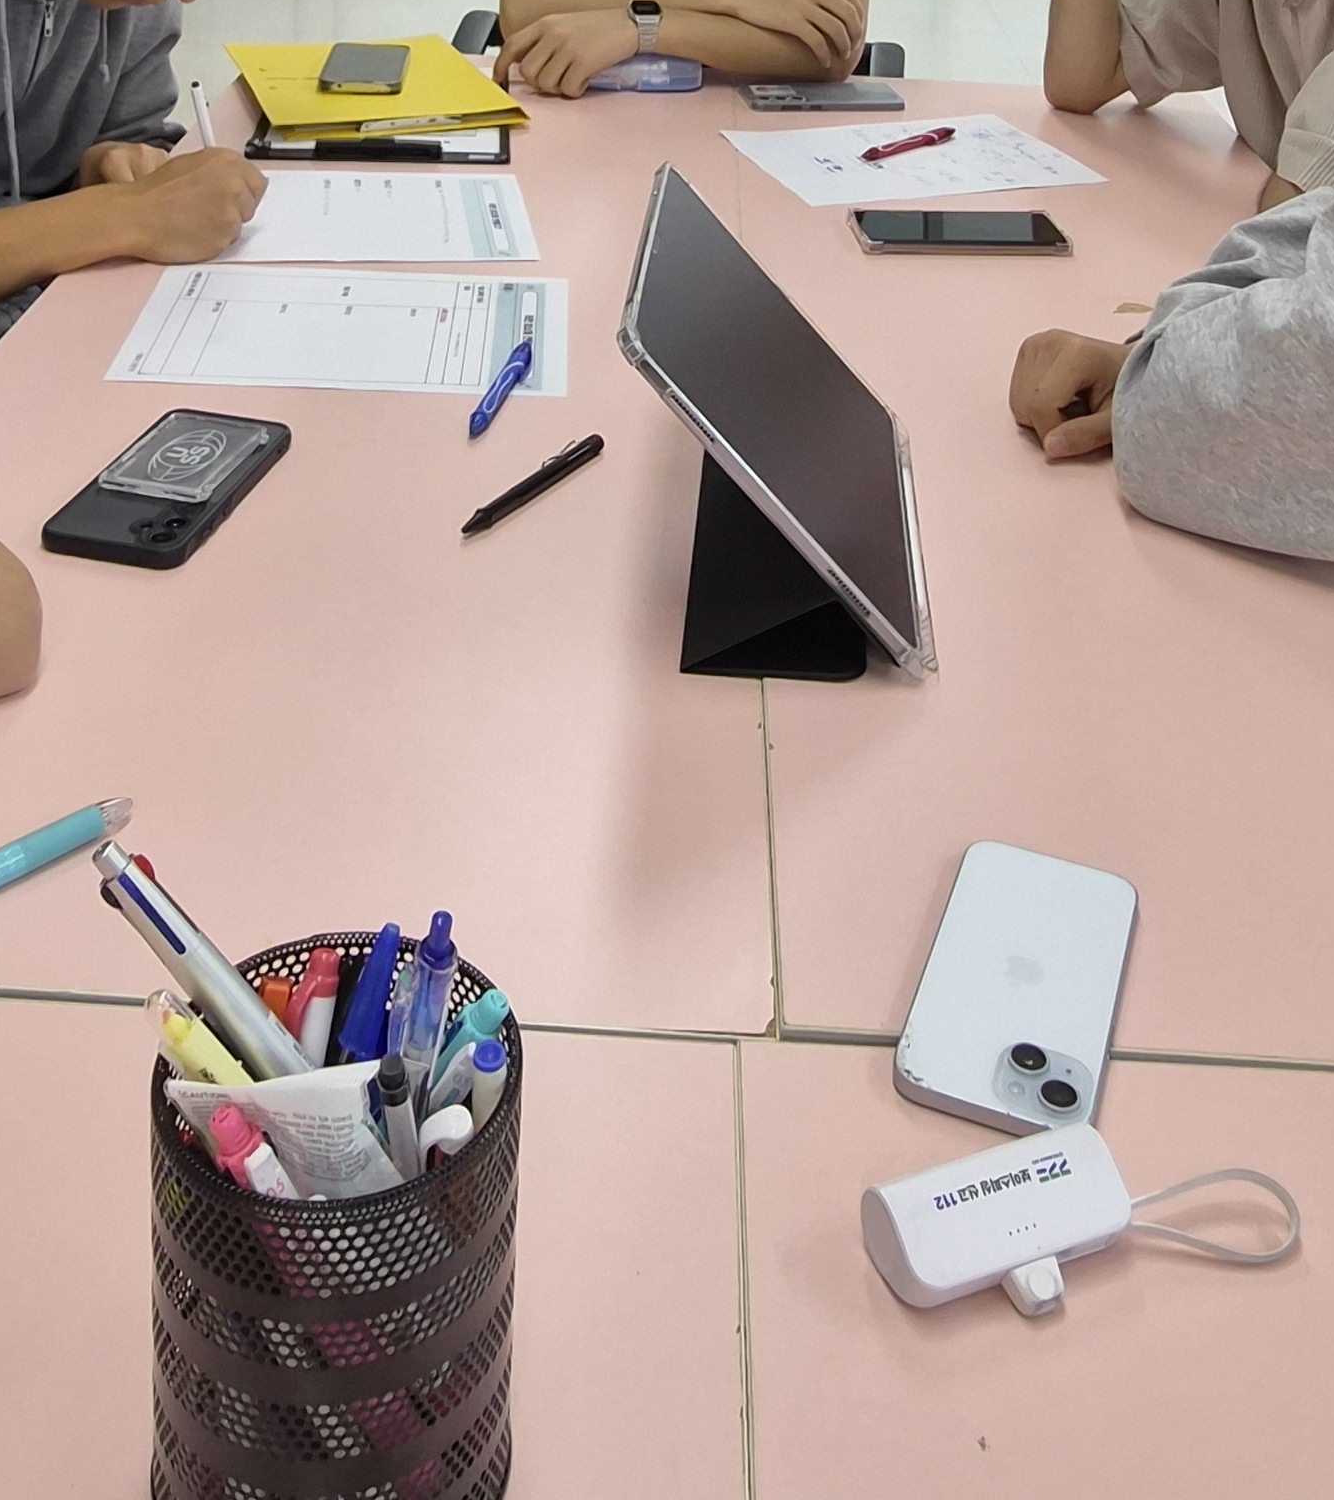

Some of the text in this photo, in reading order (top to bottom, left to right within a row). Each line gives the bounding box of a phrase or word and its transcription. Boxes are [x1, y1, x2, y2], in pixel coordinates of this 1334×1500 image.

[933, 1168, 1032, 1211] 보이스피싱 신고 112
